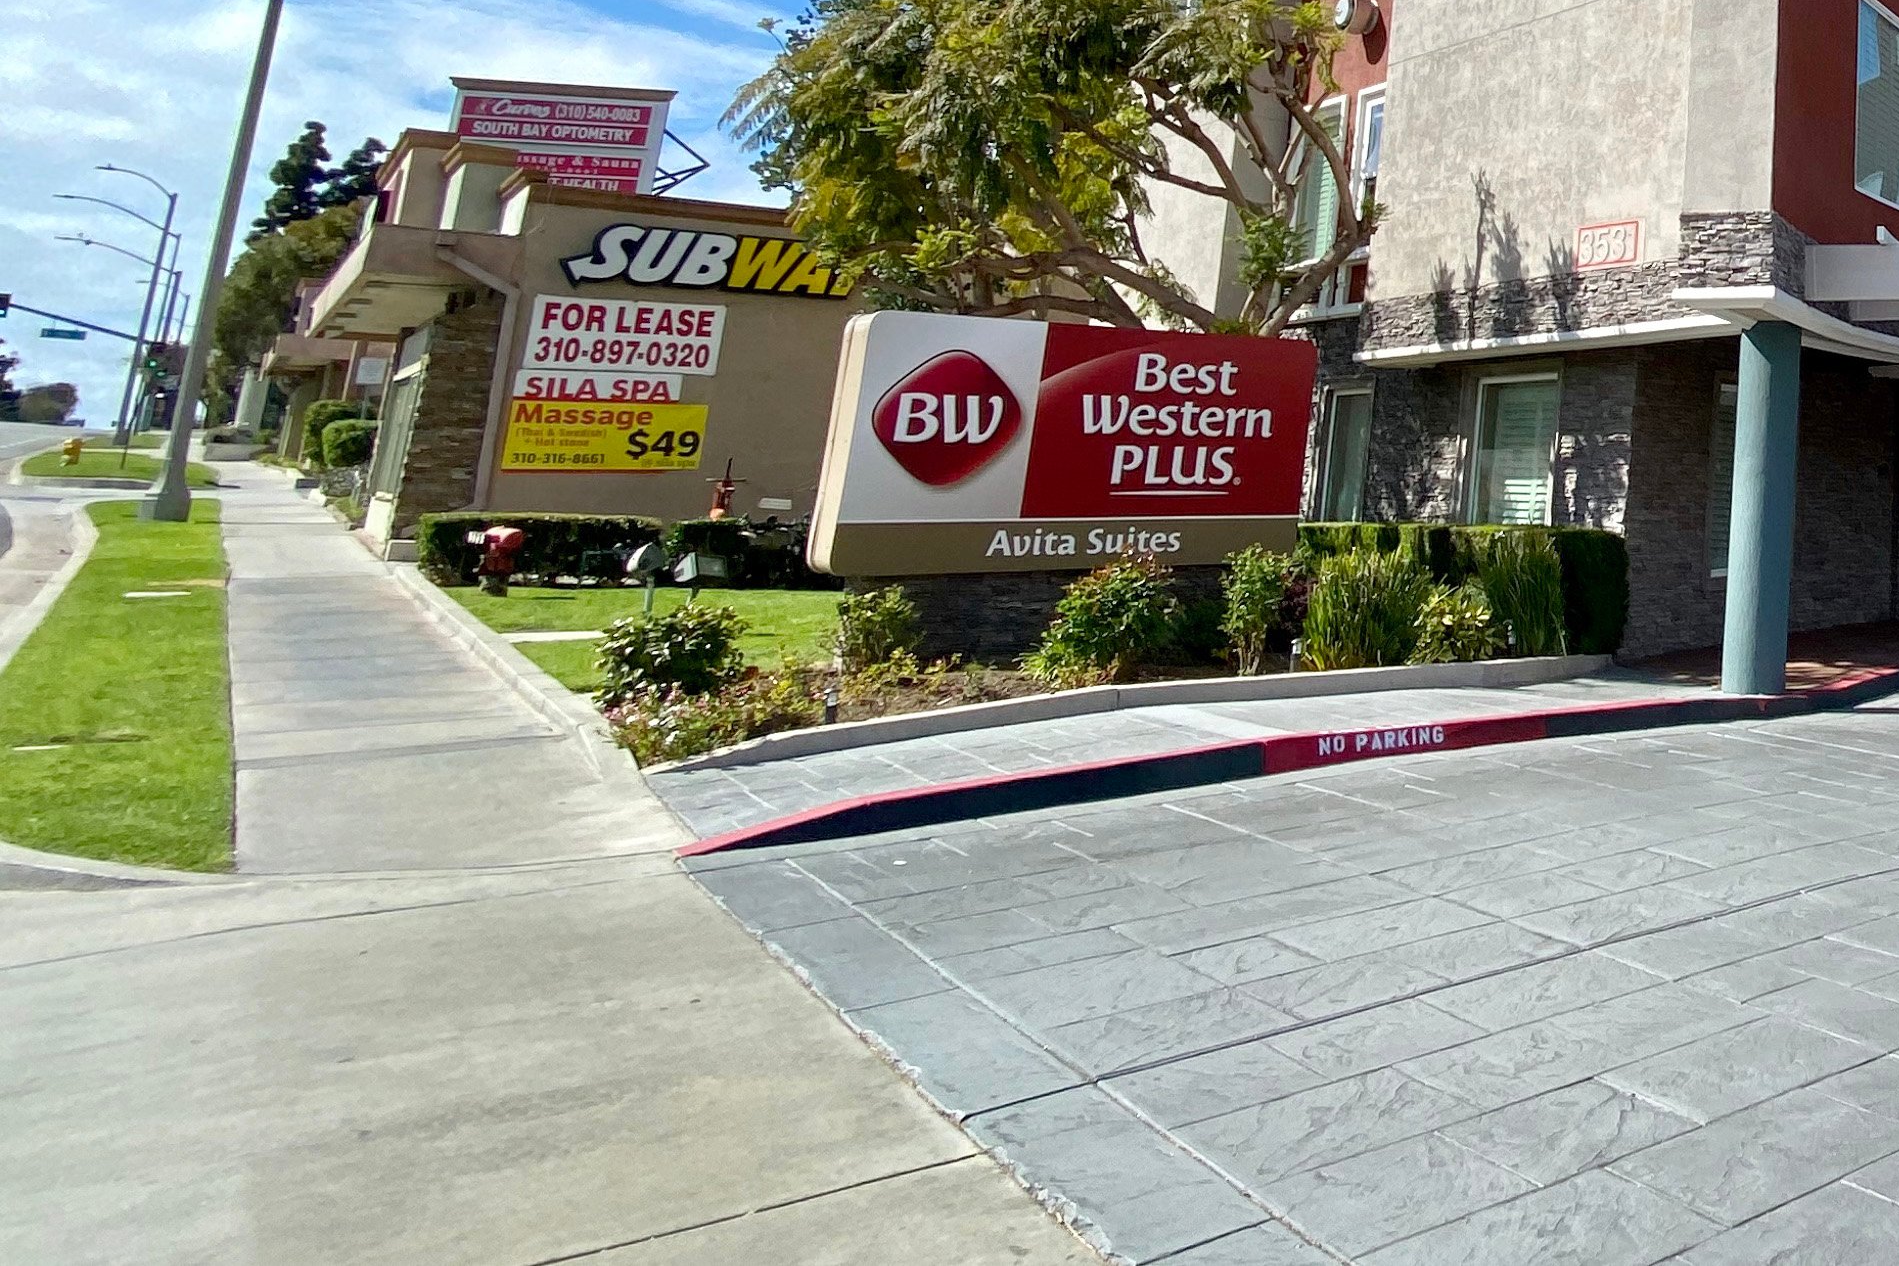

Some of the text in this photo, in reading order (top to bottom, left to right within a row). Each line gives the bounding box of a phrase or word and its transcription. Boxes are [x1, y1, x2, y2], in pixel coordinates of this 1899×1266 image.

[471, 120, 634, 142] SOUTH BAY OPTOMETRY
[541, 302, 716, 337] FOR LEASE
[534, 336, 710, 368] 310-897-0320
[524, 376, 672, 402] SILA SPA
[1134, 352, 1239, 396] Best
[514, 403, 654, 430] Massage
[893, 391, 1004, 445] BW
[1082, 393, 1273, 439] Western
[625, 428, 700, 460] $49
[1110, 445, 1235, 486] PLUS
[985, 526, 1181, 557] Avita Suites
[1318, 726, 1445, 756] NO PARKING
